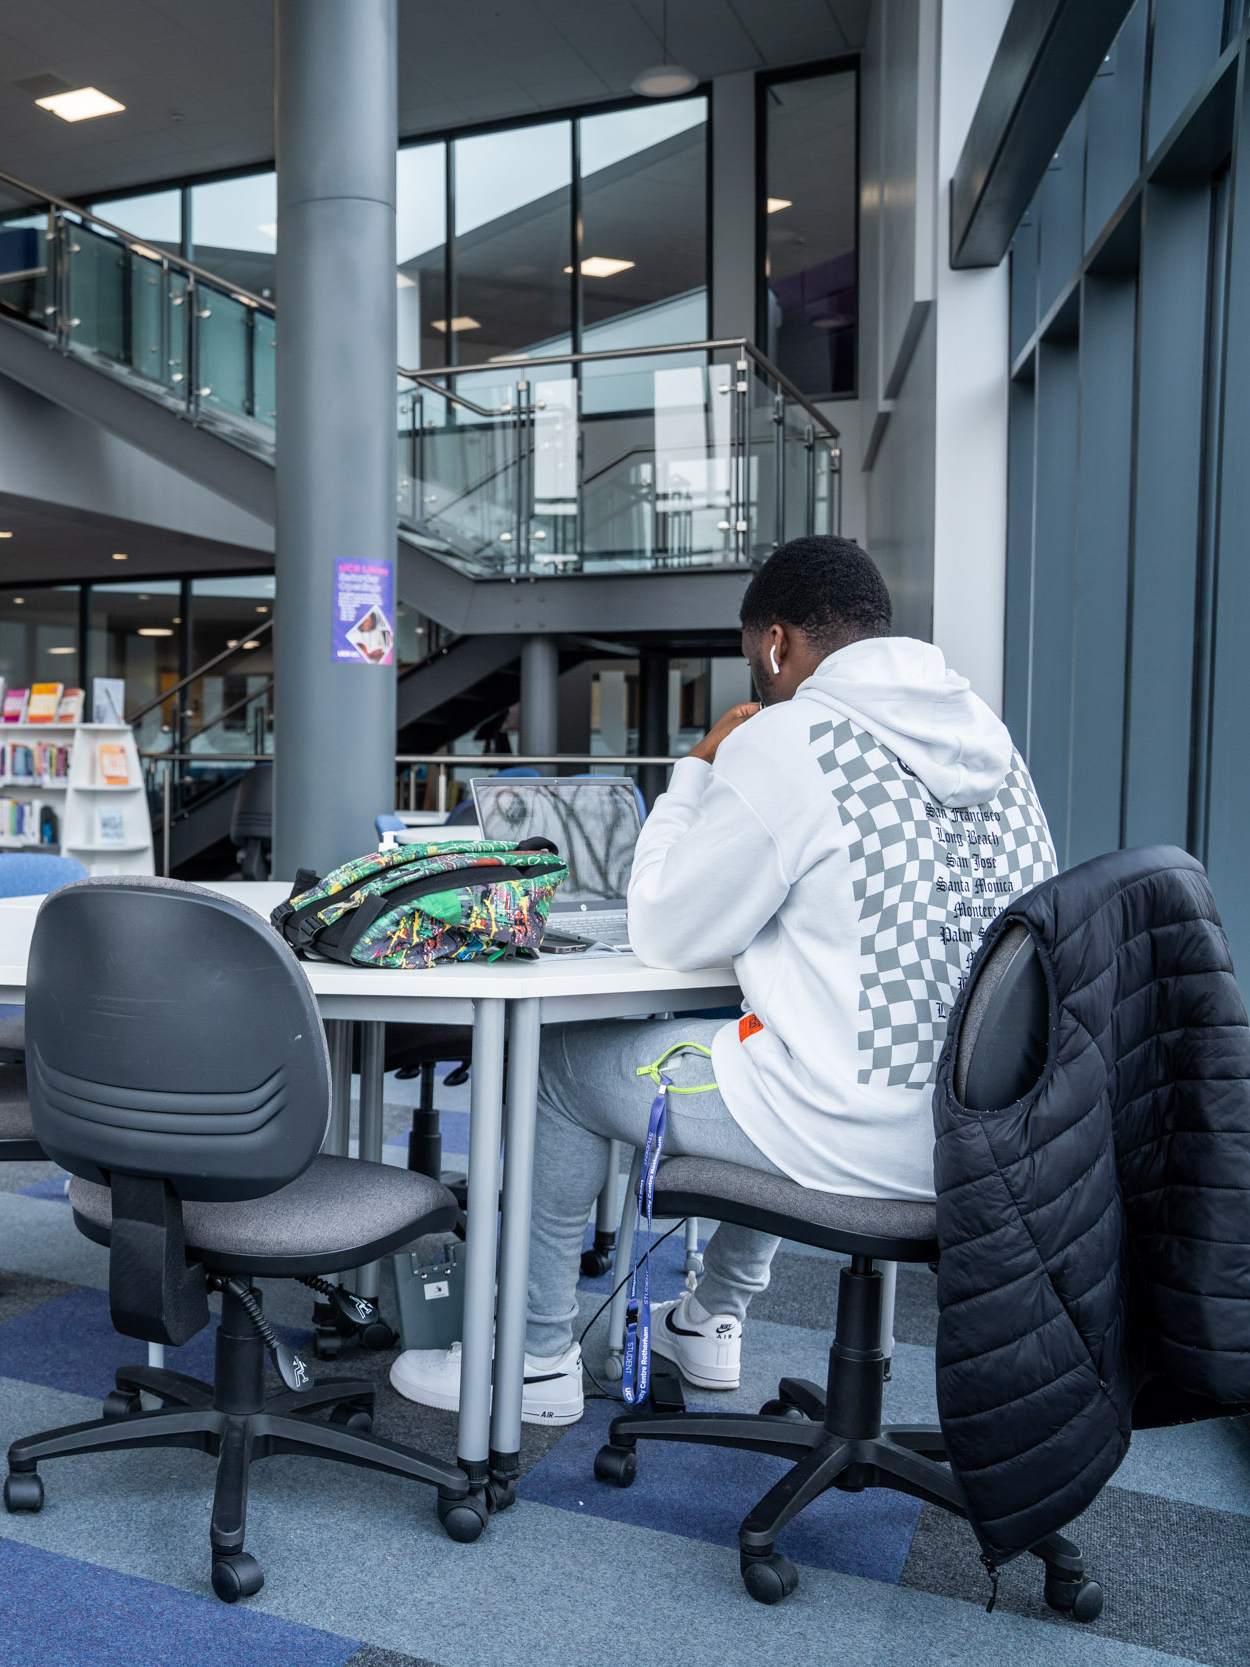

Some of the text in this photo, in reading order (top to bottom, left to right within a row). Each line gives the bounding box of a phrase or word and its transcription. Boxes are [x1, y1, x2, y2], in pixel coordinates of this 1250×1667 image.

[925, 802, 1001, 823] San Francisco
[935, 826, 1000, 848] Long Beach
[945, 852, 997, 871] San Jose
[935, 876, 1014, 894] Santa Monica
[939, 926, 974, 946] Palm
[640, 1326, 649, 1365] Rotherham
[625, 1342, 634, 1375] STUDENT
[639, 1366, 648, 1389] Centre
[540, 1410, 555, 1419] AIR
